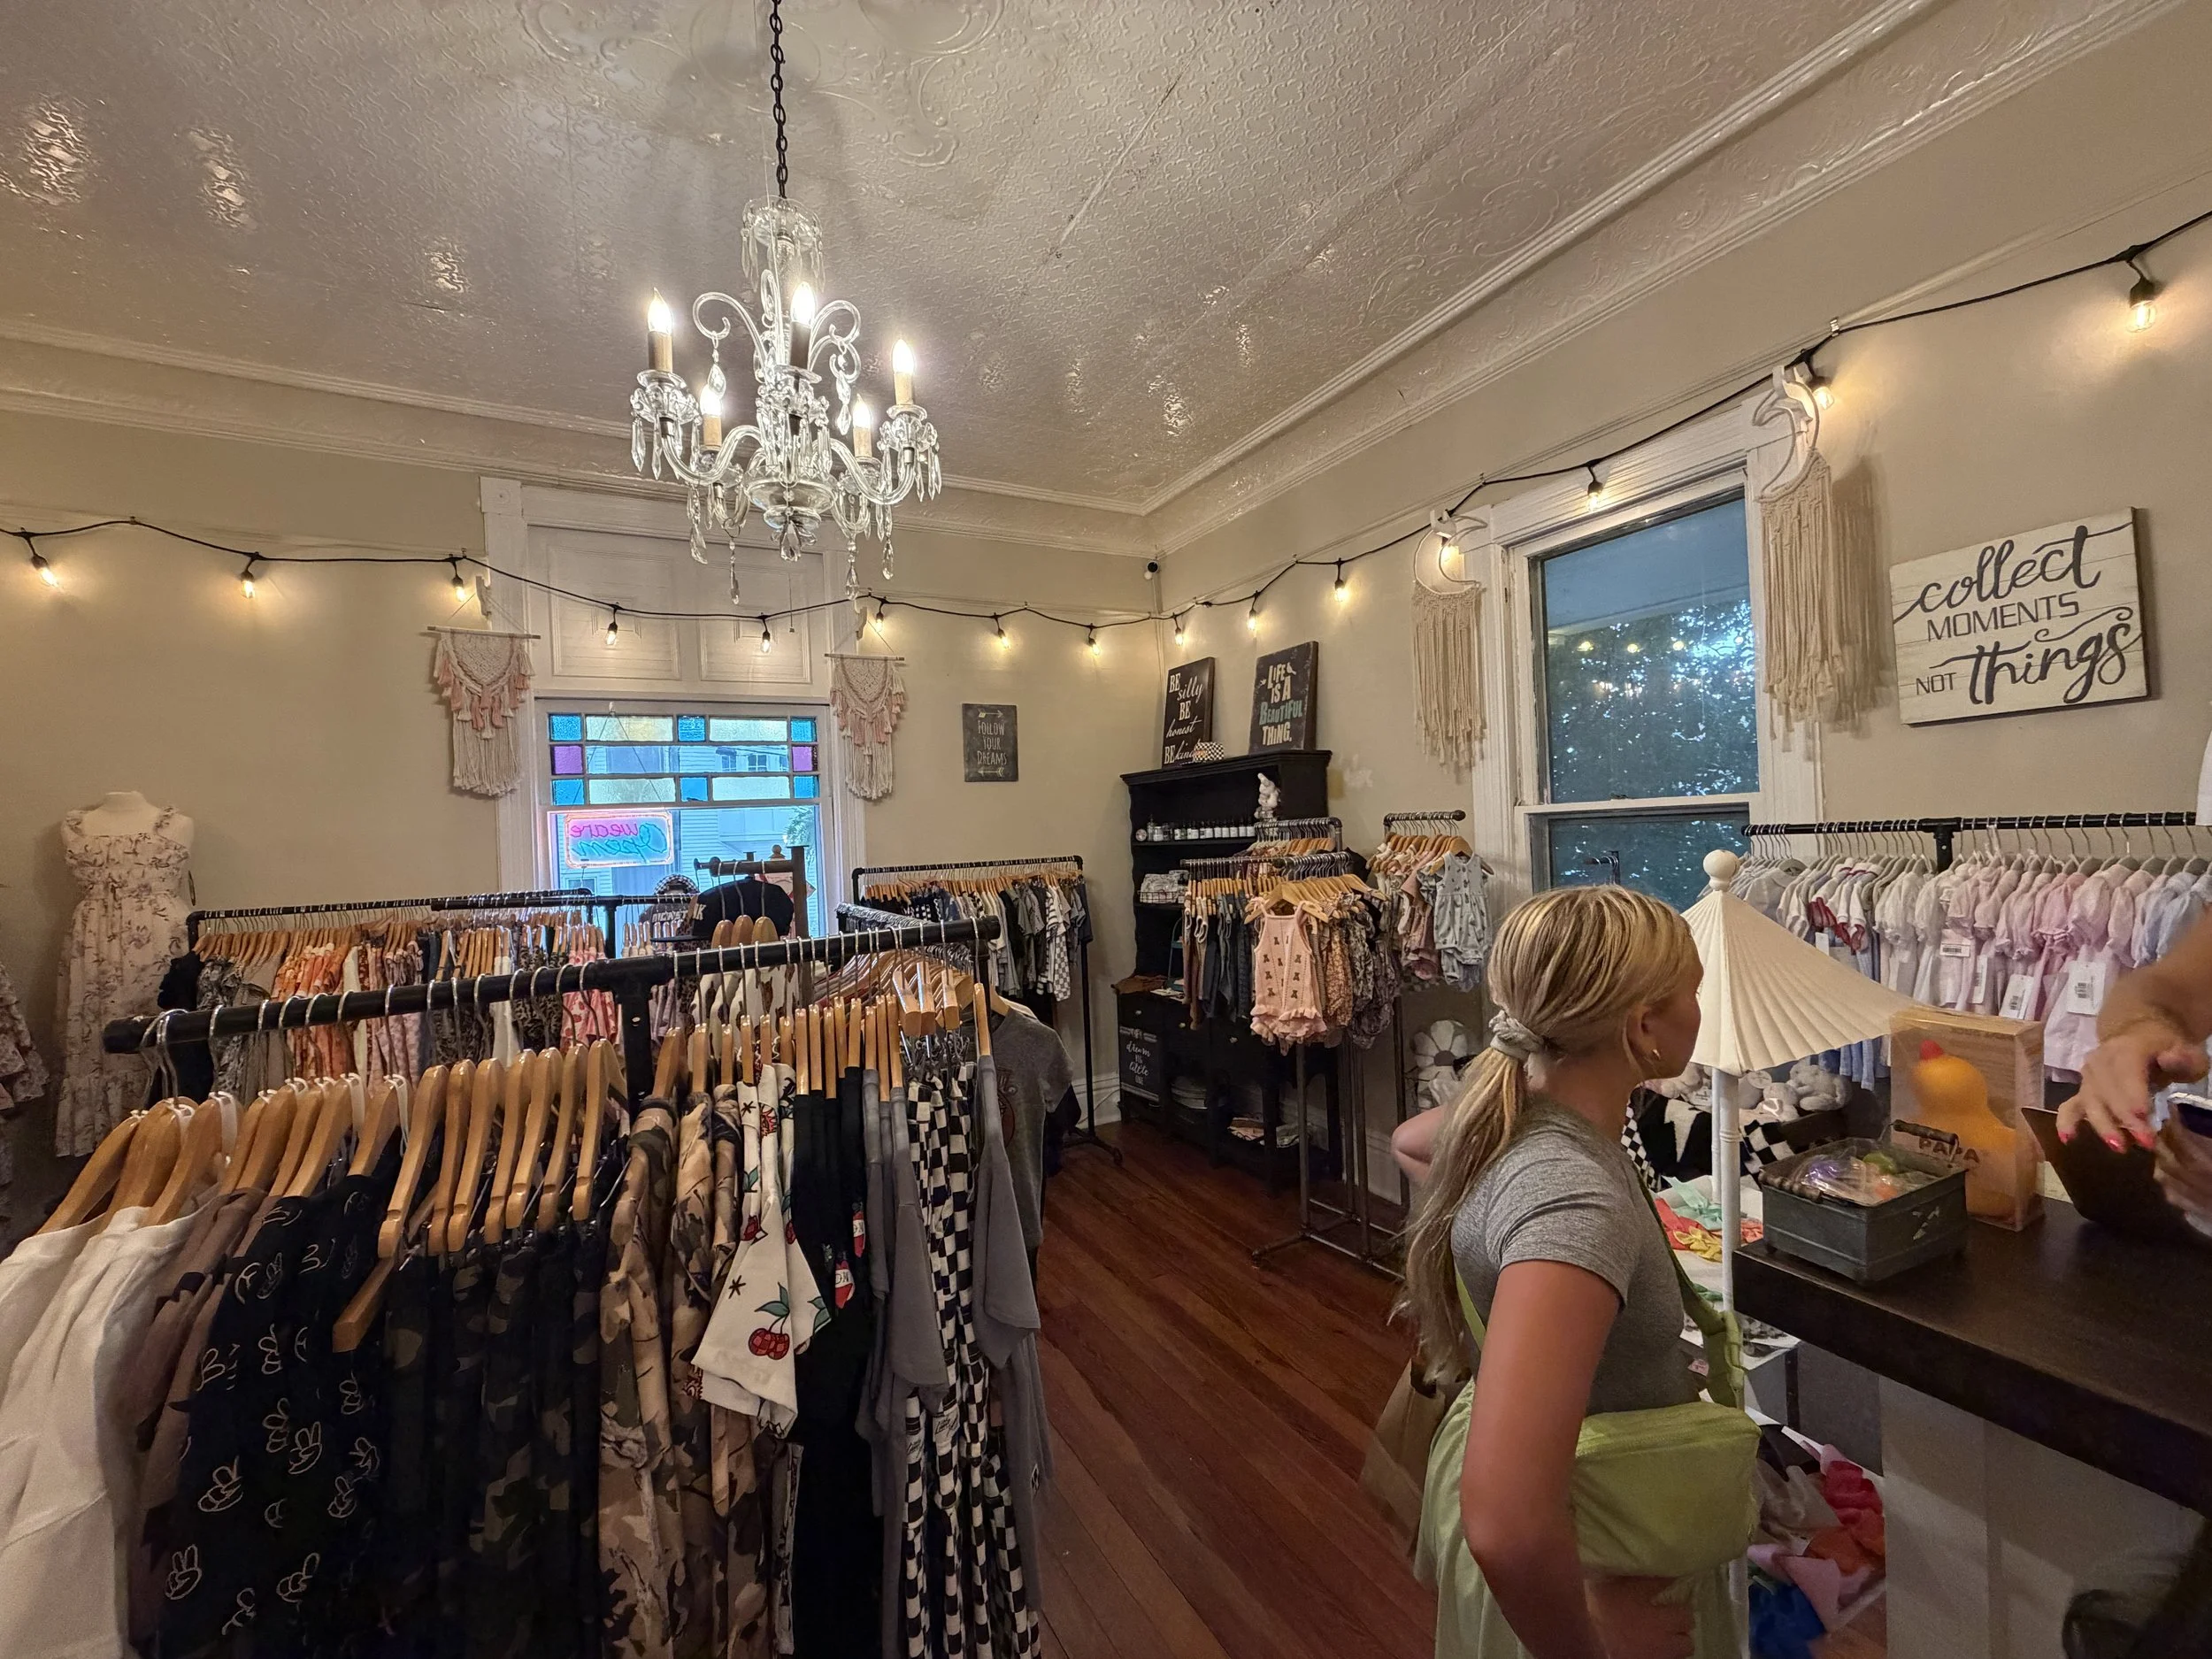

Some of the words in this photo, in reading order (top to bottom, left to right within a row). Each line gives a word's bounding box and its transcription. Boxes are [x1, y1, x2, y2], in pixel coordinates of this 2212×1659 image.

[1893, 523, 2132, 624] collect
[1927, 591, 2079, 641] MOMENTS
[1930, 618, 2142, 704] things
[1169, 672, 1181, 693] BE
[1177, 676, 1204, 704] silly
[1282, 676, 1292, 702] A
[1916, 672, 1957, 695] NOT
[1179, 700, 1192, 721] BE
[1259, 700, 1303, 726] BEAUTIFUL
[978, 719, 1005, 735] FOLLOW
[1166, 715, 1202, 738] honest
[983, 735, 1002, 750] YOUR
[977, 750, 1007, 765] DREAMS
[1164, 745, 1176, 764] BE
